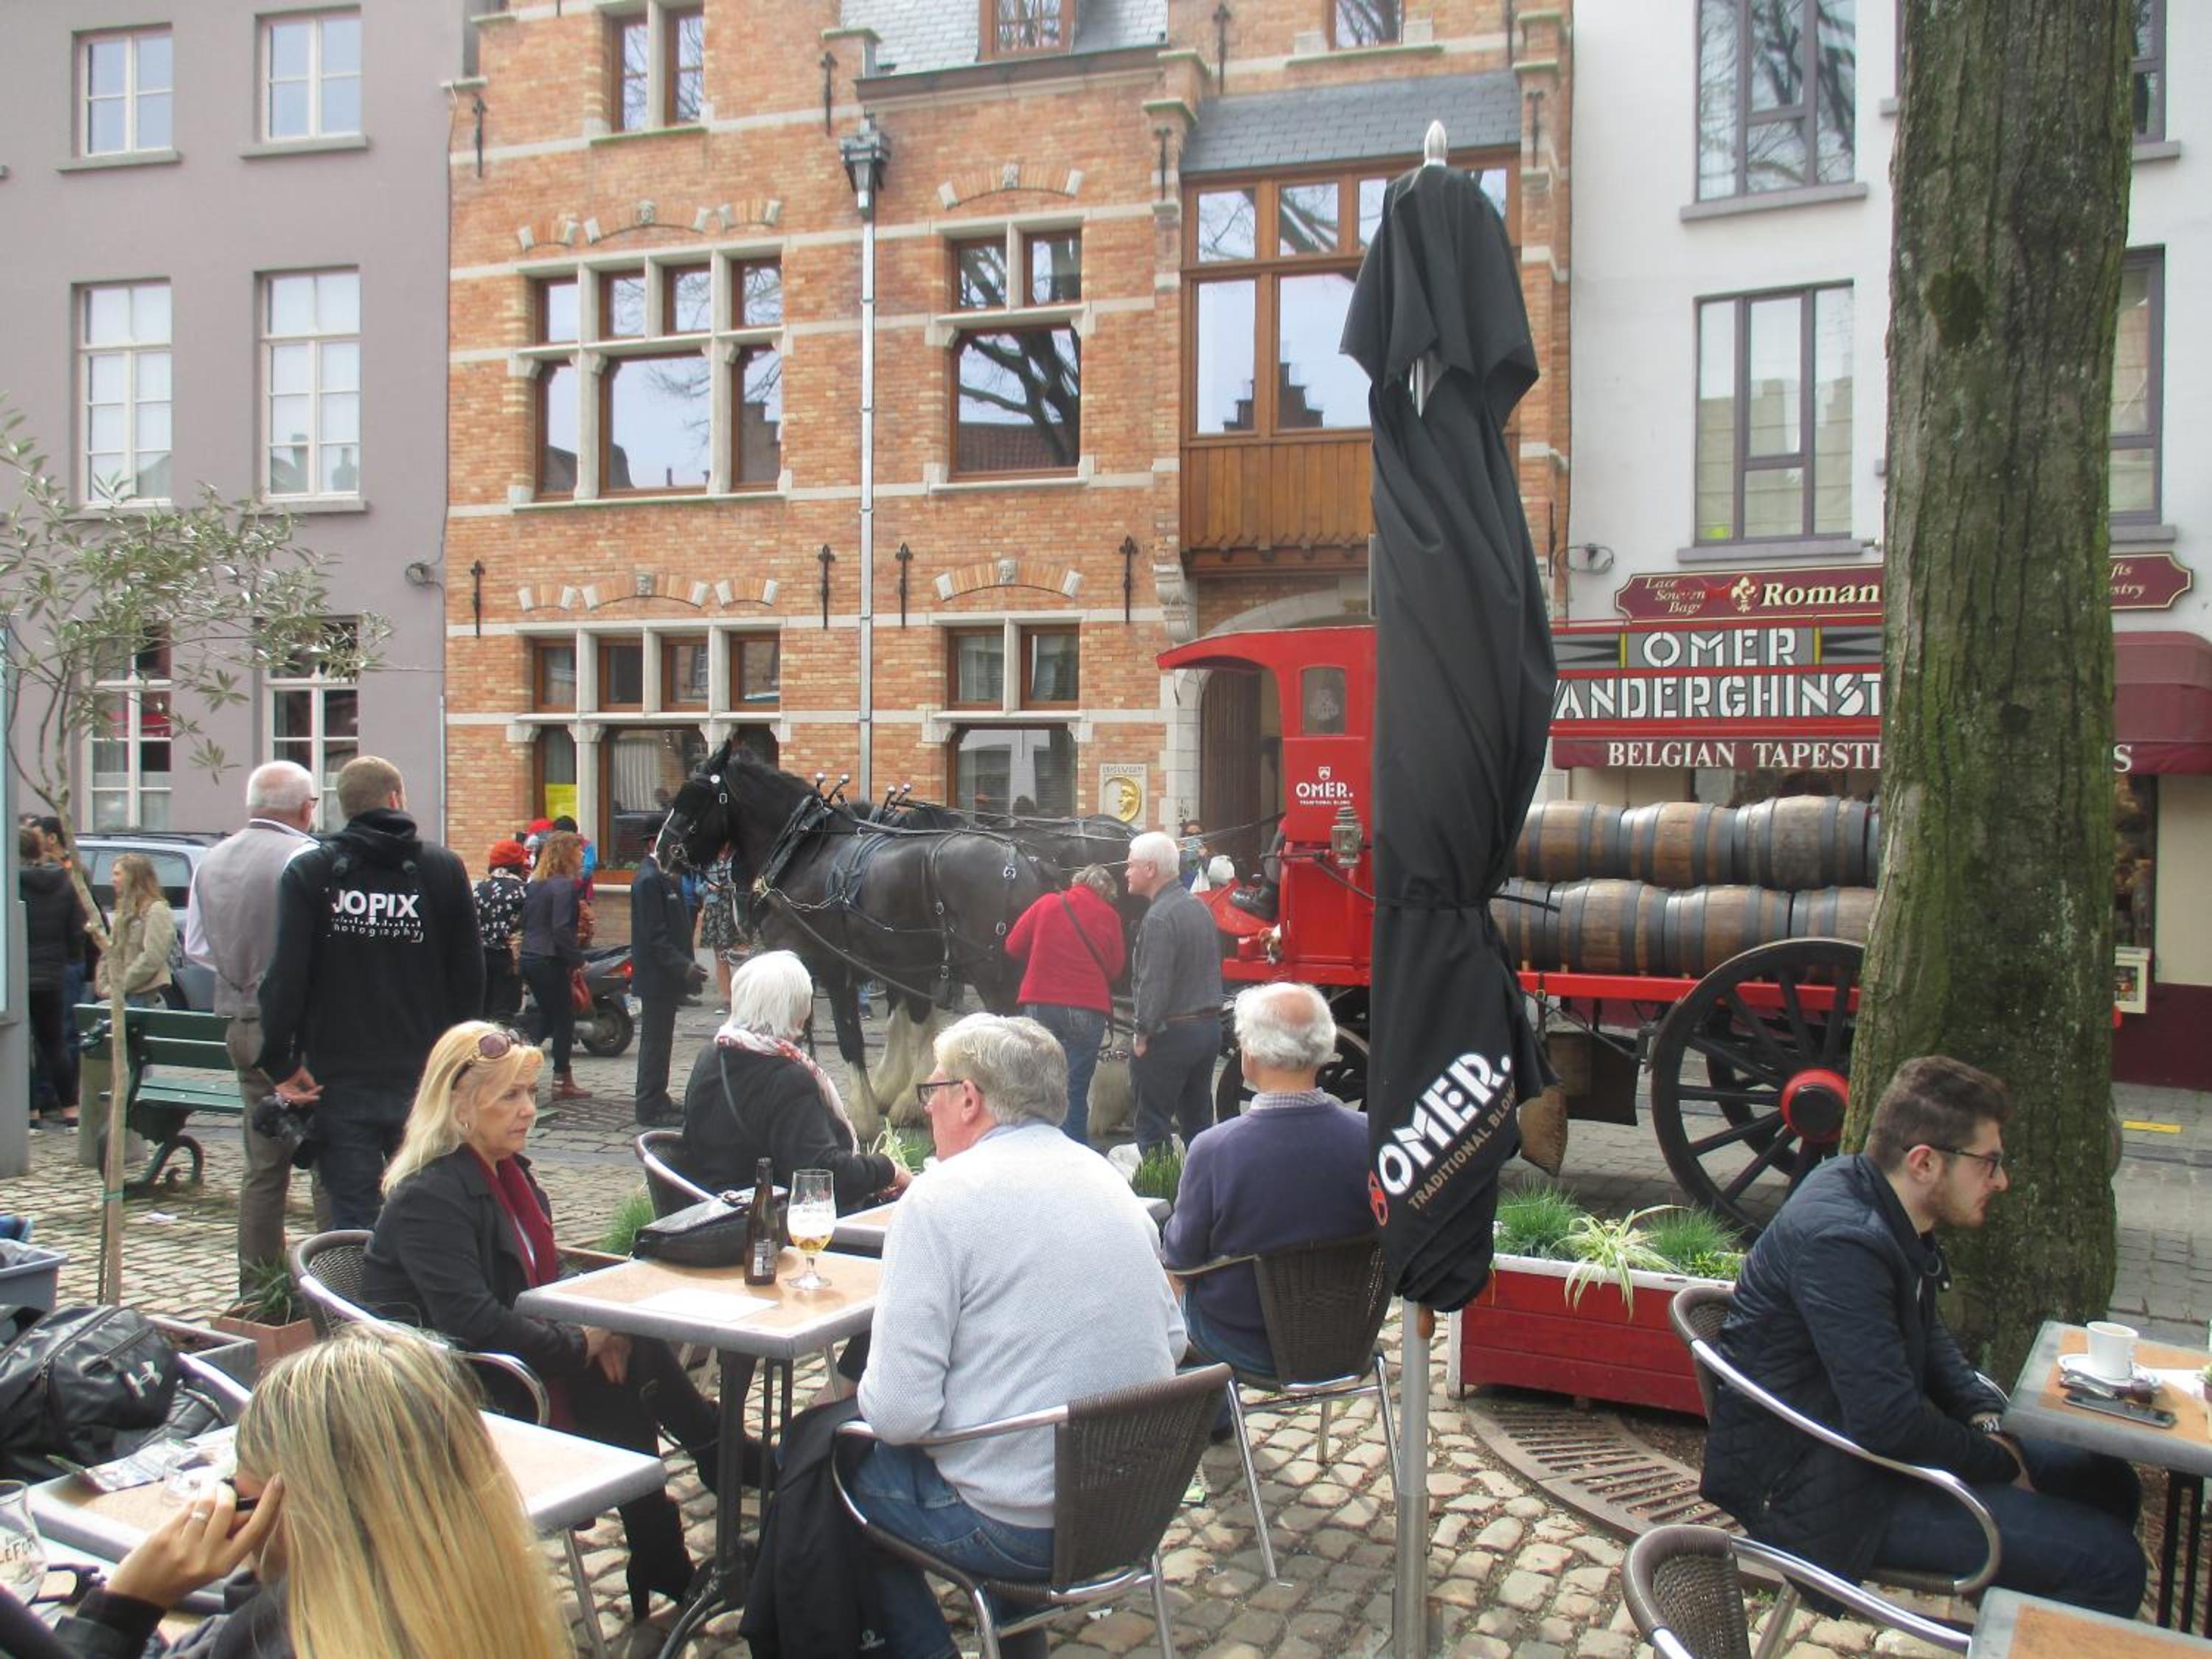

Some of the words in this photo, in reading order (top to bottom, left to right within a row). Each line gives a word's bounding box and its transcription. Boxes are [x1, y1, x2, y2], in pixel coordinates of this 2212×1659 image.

[1645, 577, 1677, 589] Lace
[1761, 582, 1880, 606] Roman
[1643, 628, 1795, 667] OMER
[1554, 672, 1881, 719] ANDERGHINST
[1607, 742, 1736, 768] BELGIAN
[332, 889, 420, 922] JOPIX
[1408, 1128, 1492, 1210] TRADITIONAL
